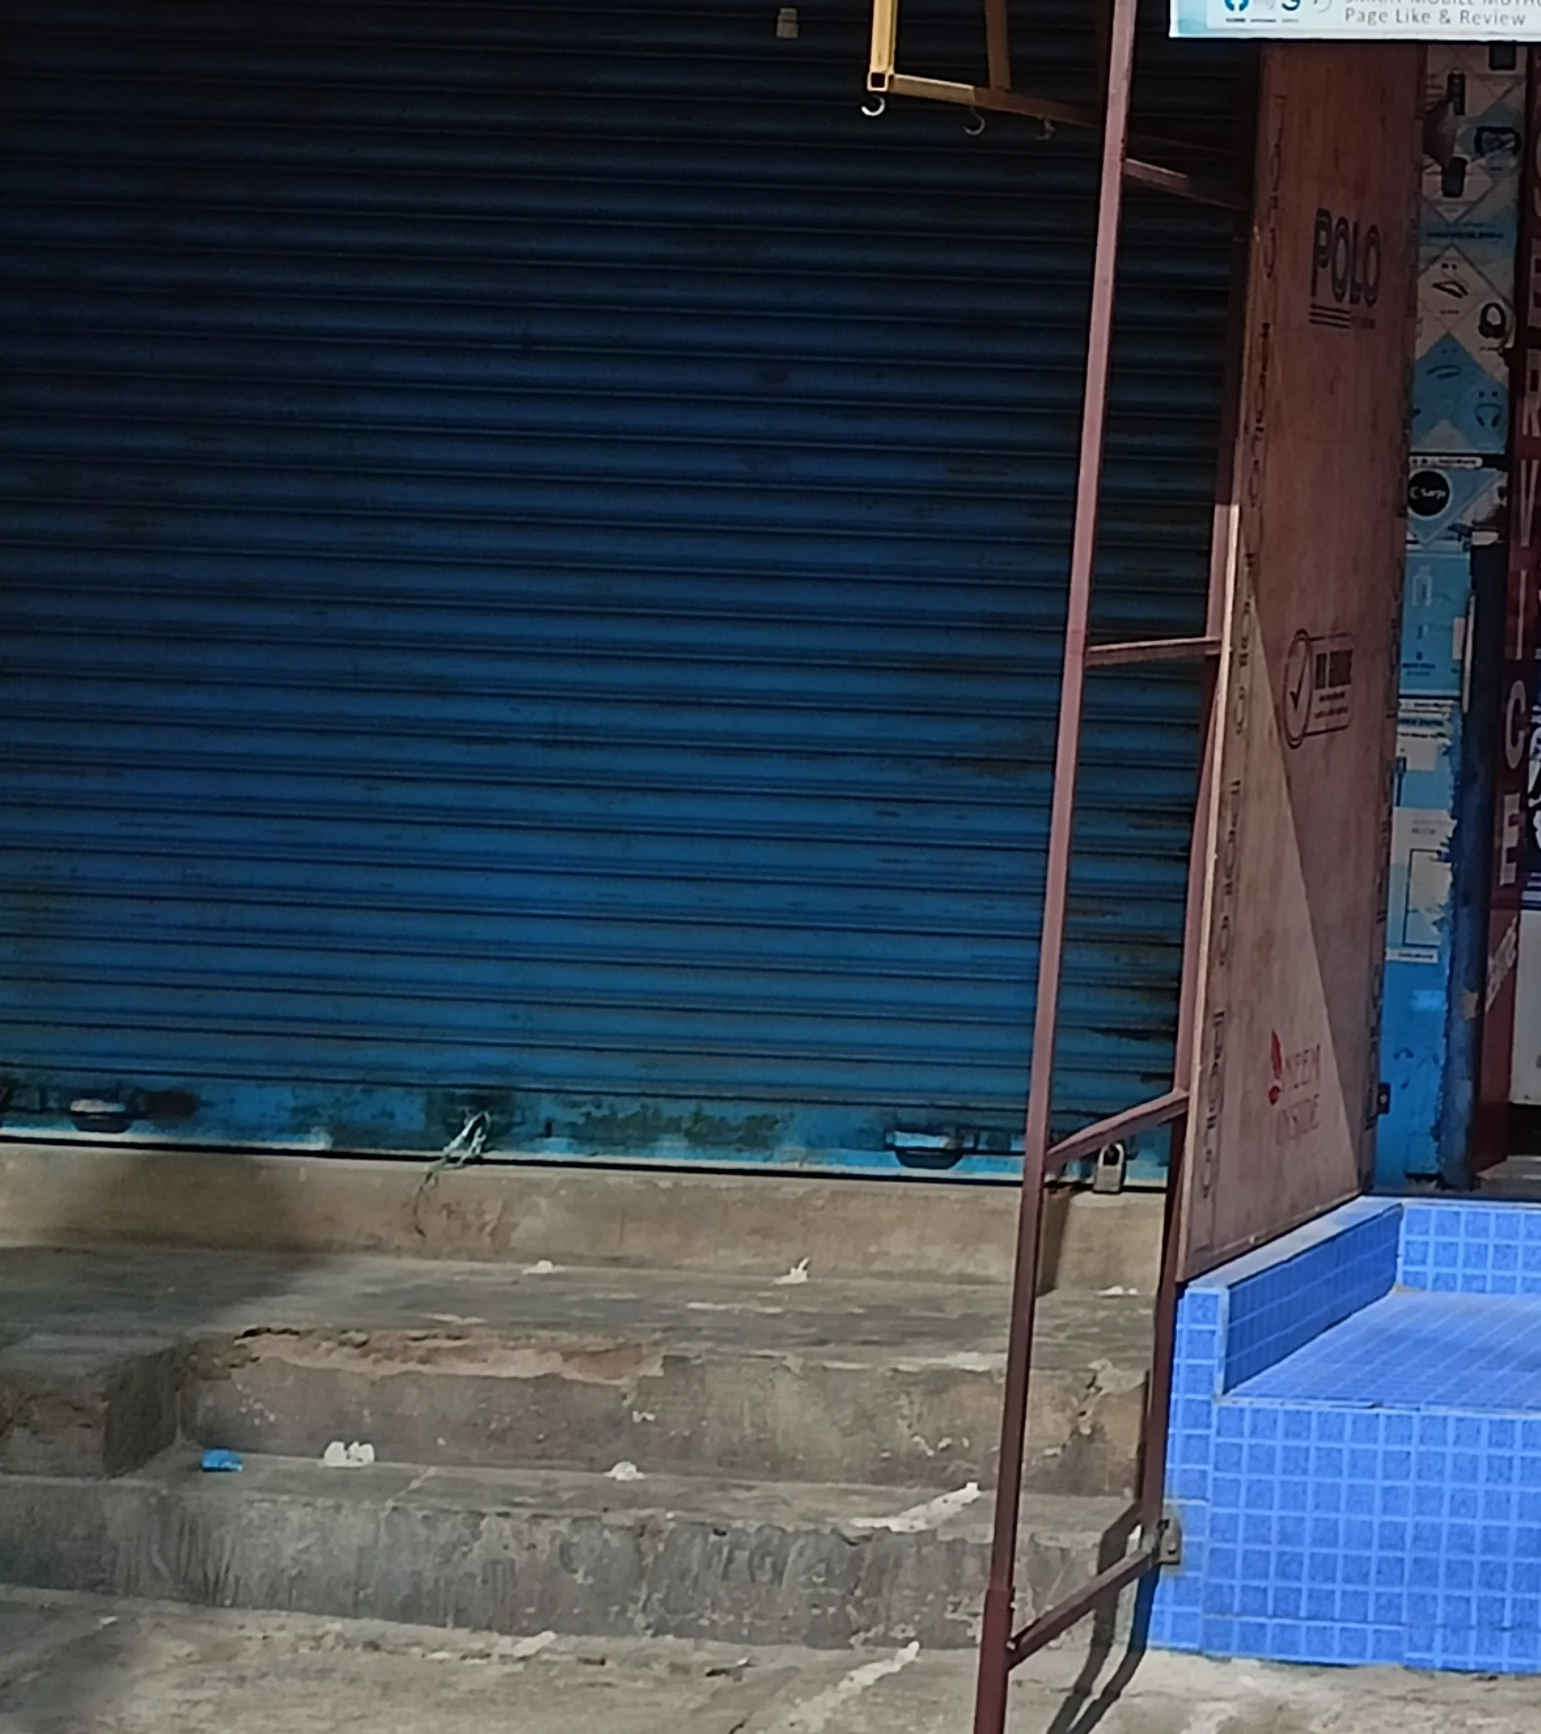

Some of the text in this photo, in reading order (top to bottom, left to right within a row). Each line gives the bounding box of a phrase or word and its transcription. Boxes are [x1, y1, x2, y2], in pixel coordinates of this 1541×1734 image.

[1345, 8, 1525, 26] Page Like & Review
[1310, 207, 1381, 308] POLO
